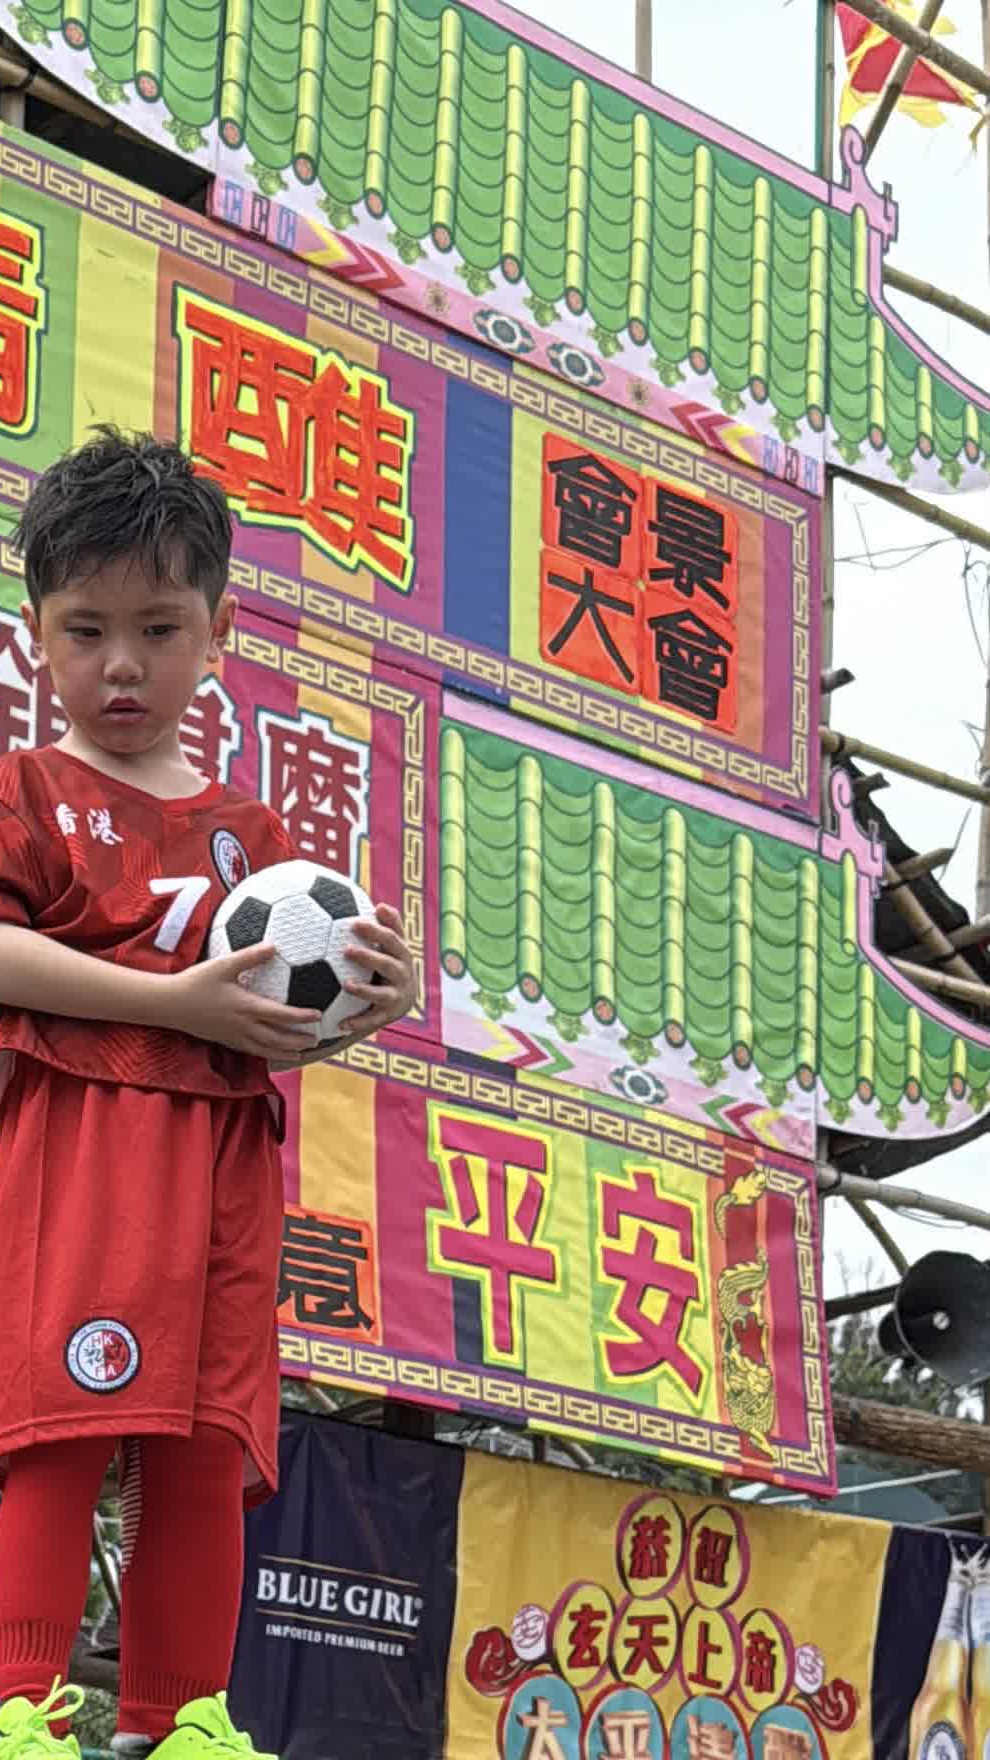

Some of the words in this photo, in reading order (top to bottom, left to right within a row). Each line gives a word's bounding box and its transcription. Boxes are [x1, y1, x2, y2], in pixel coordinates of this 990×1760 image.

[148, 875, 212, 954] 7
[436, 1106, 707, 1400] 平安
[256, 1567, 339, 1612] BLUE
[627, 1515, 735, 1588] 恭祝
[324, 1631, 377, 1653] PREMIUM
[377, 1640, 405, 1657] BEER
[566, 1602, 778, 1695] 玄天上帝
